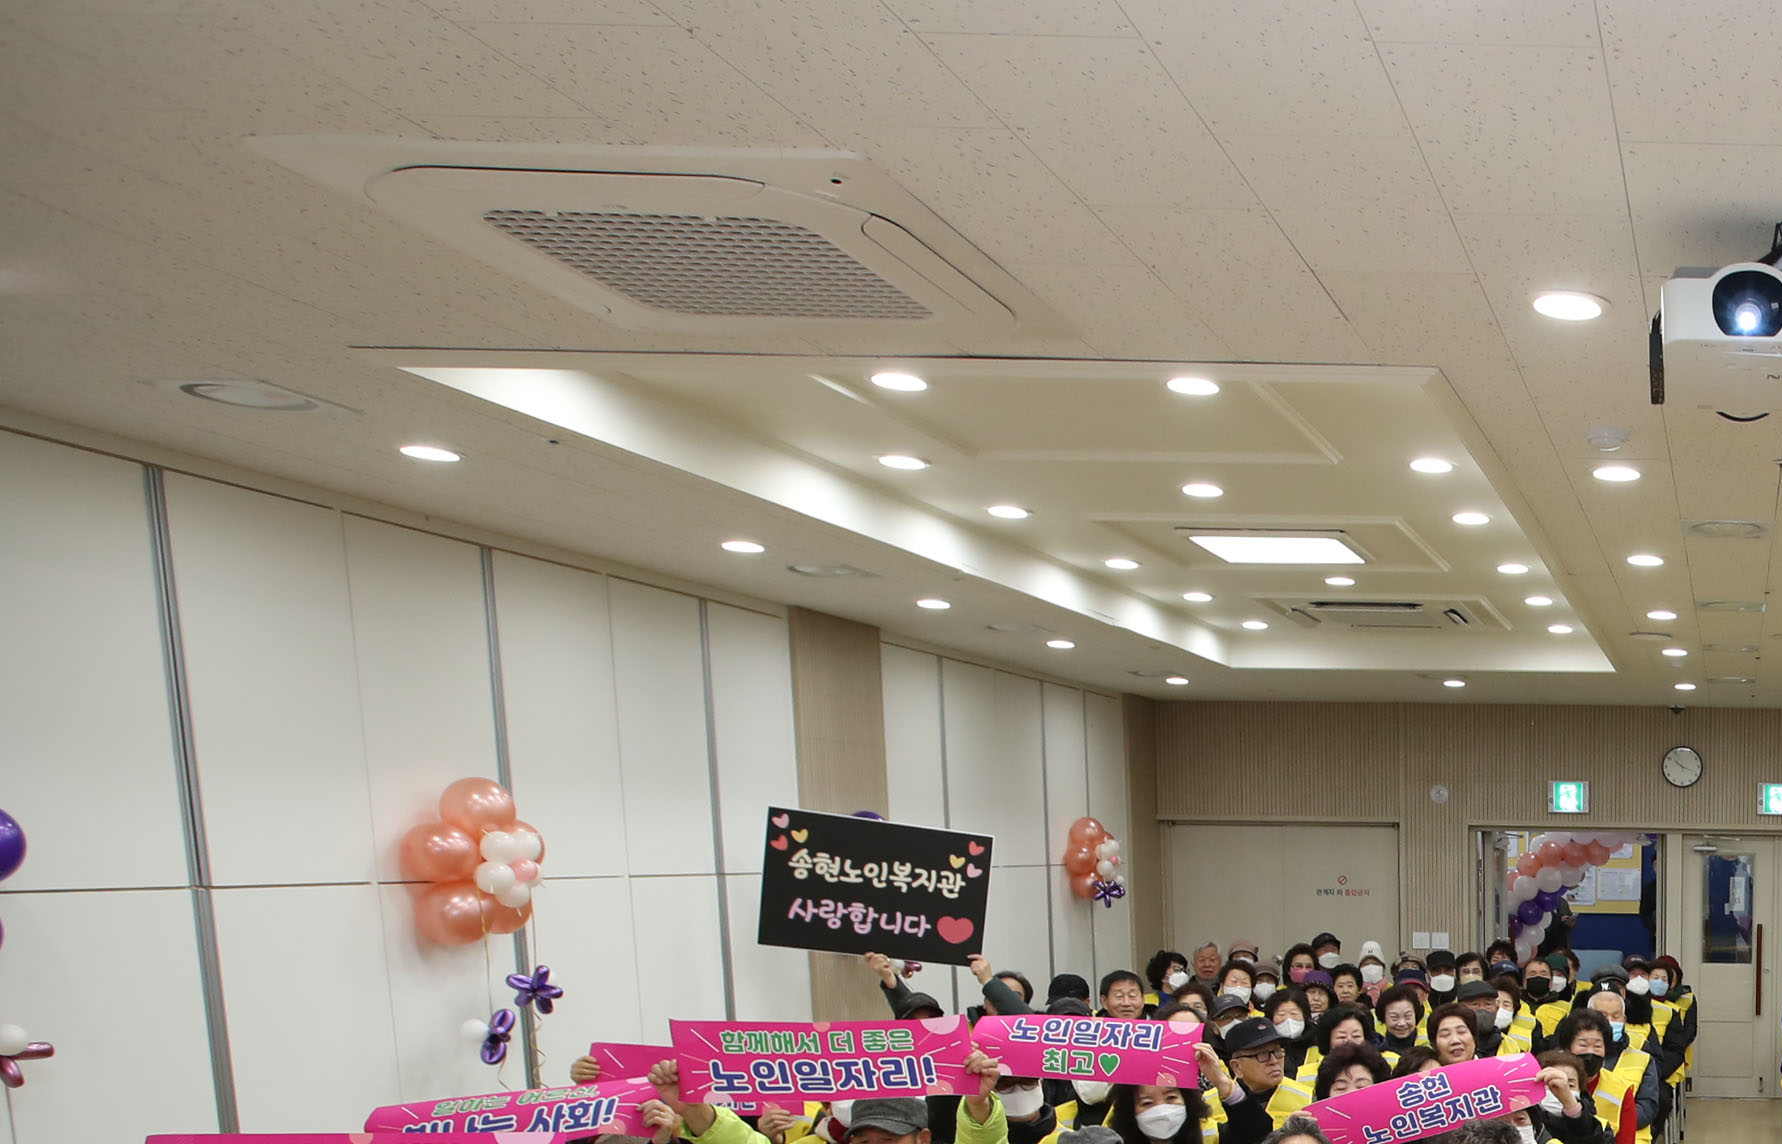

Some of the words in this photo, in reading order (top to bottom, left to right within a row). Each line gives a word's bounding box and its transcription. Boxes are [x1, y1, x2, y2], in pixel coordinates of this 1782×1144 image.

[788, 848, 966, 899] 송현노인복지관
[788, 898, 931, 938] 사랑합니다
[720, 1031, 820, 1055] 함께해서
[829, 1031, 854, 1054] 더
[862, 1029, 915, 1052] 좋은
[1010, 1017, 1164, 1051] 노인일자리
[709, 1056, 937, 1094] 노인일자리!
[1043, 1048, 1095, 1076] 최고
[431, 1096, 512, 1117] 일하는
[1396, 1072, 1452, 1108] 송현
[527, 1097, 619, 1132] 사회!
